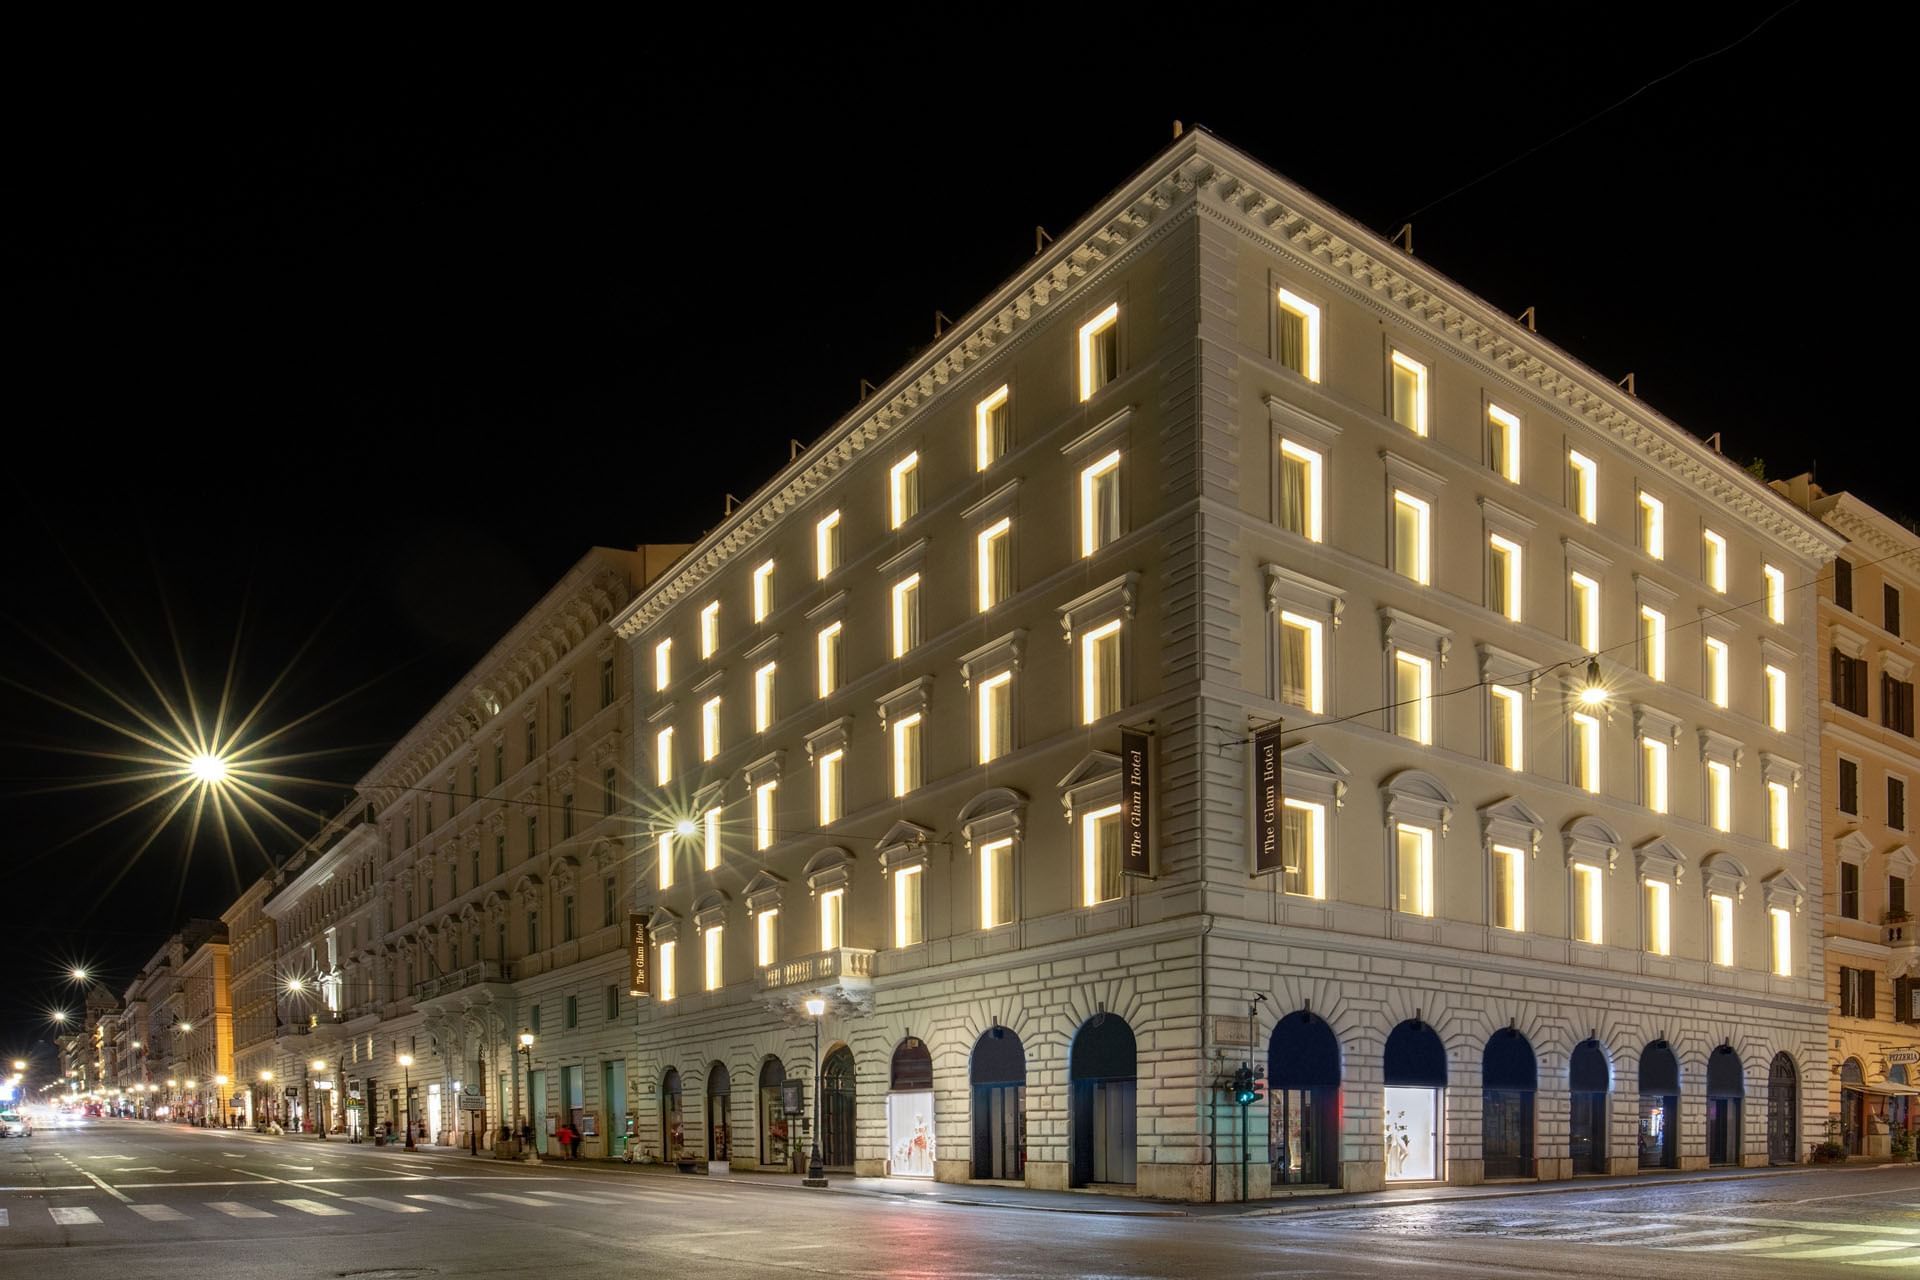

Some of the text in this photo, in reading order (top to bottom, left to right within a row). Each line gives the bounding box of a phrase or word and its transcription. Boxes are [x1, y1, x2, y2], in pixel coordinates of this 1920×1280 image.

[1130, 750, 1142, 857] The Glam Hotel
[1263, 743, 1275, 855] The Glam Hotel
[636, 923, 645, 985] The Glam Hotel
[1888, 1053, 1918, 1062] PIZZERIA
